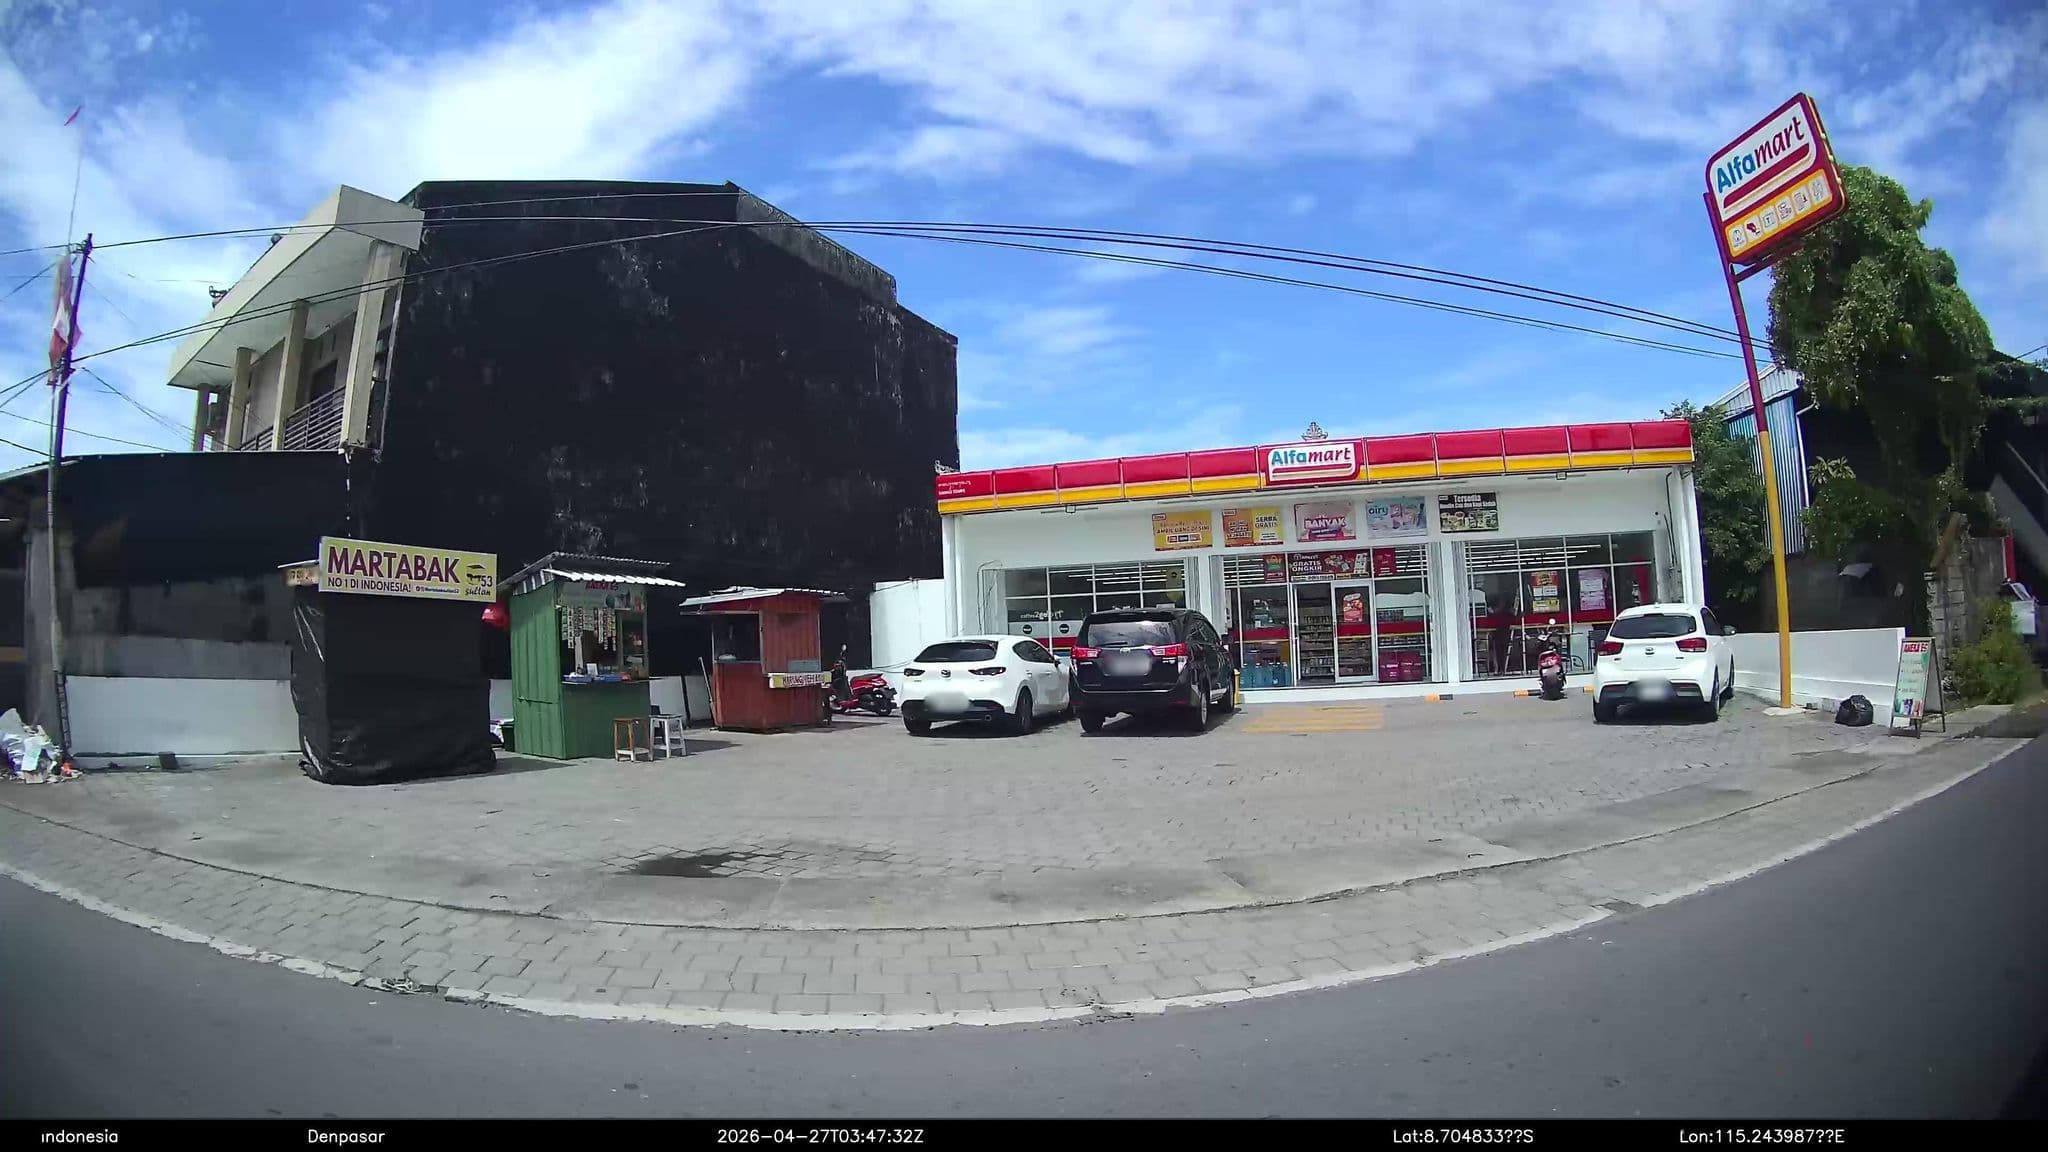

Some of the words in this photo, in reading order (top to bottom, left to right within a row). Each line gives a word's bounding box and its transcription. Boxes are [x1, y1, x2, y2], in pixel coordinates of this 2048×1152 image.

[1716, 116, 1805, 194] Alfamart
[1271, 447, 1351, 465] Alfamart
[327, 546, 460, 584] MARTABAK
[327, 577, 342, 587] NO
[344, 579, 348, 588] 1
[350, 579, 359, 588] DI
[361, 580, 411, 592] INDONESIA!
[480, 575, 493, 587] 53
